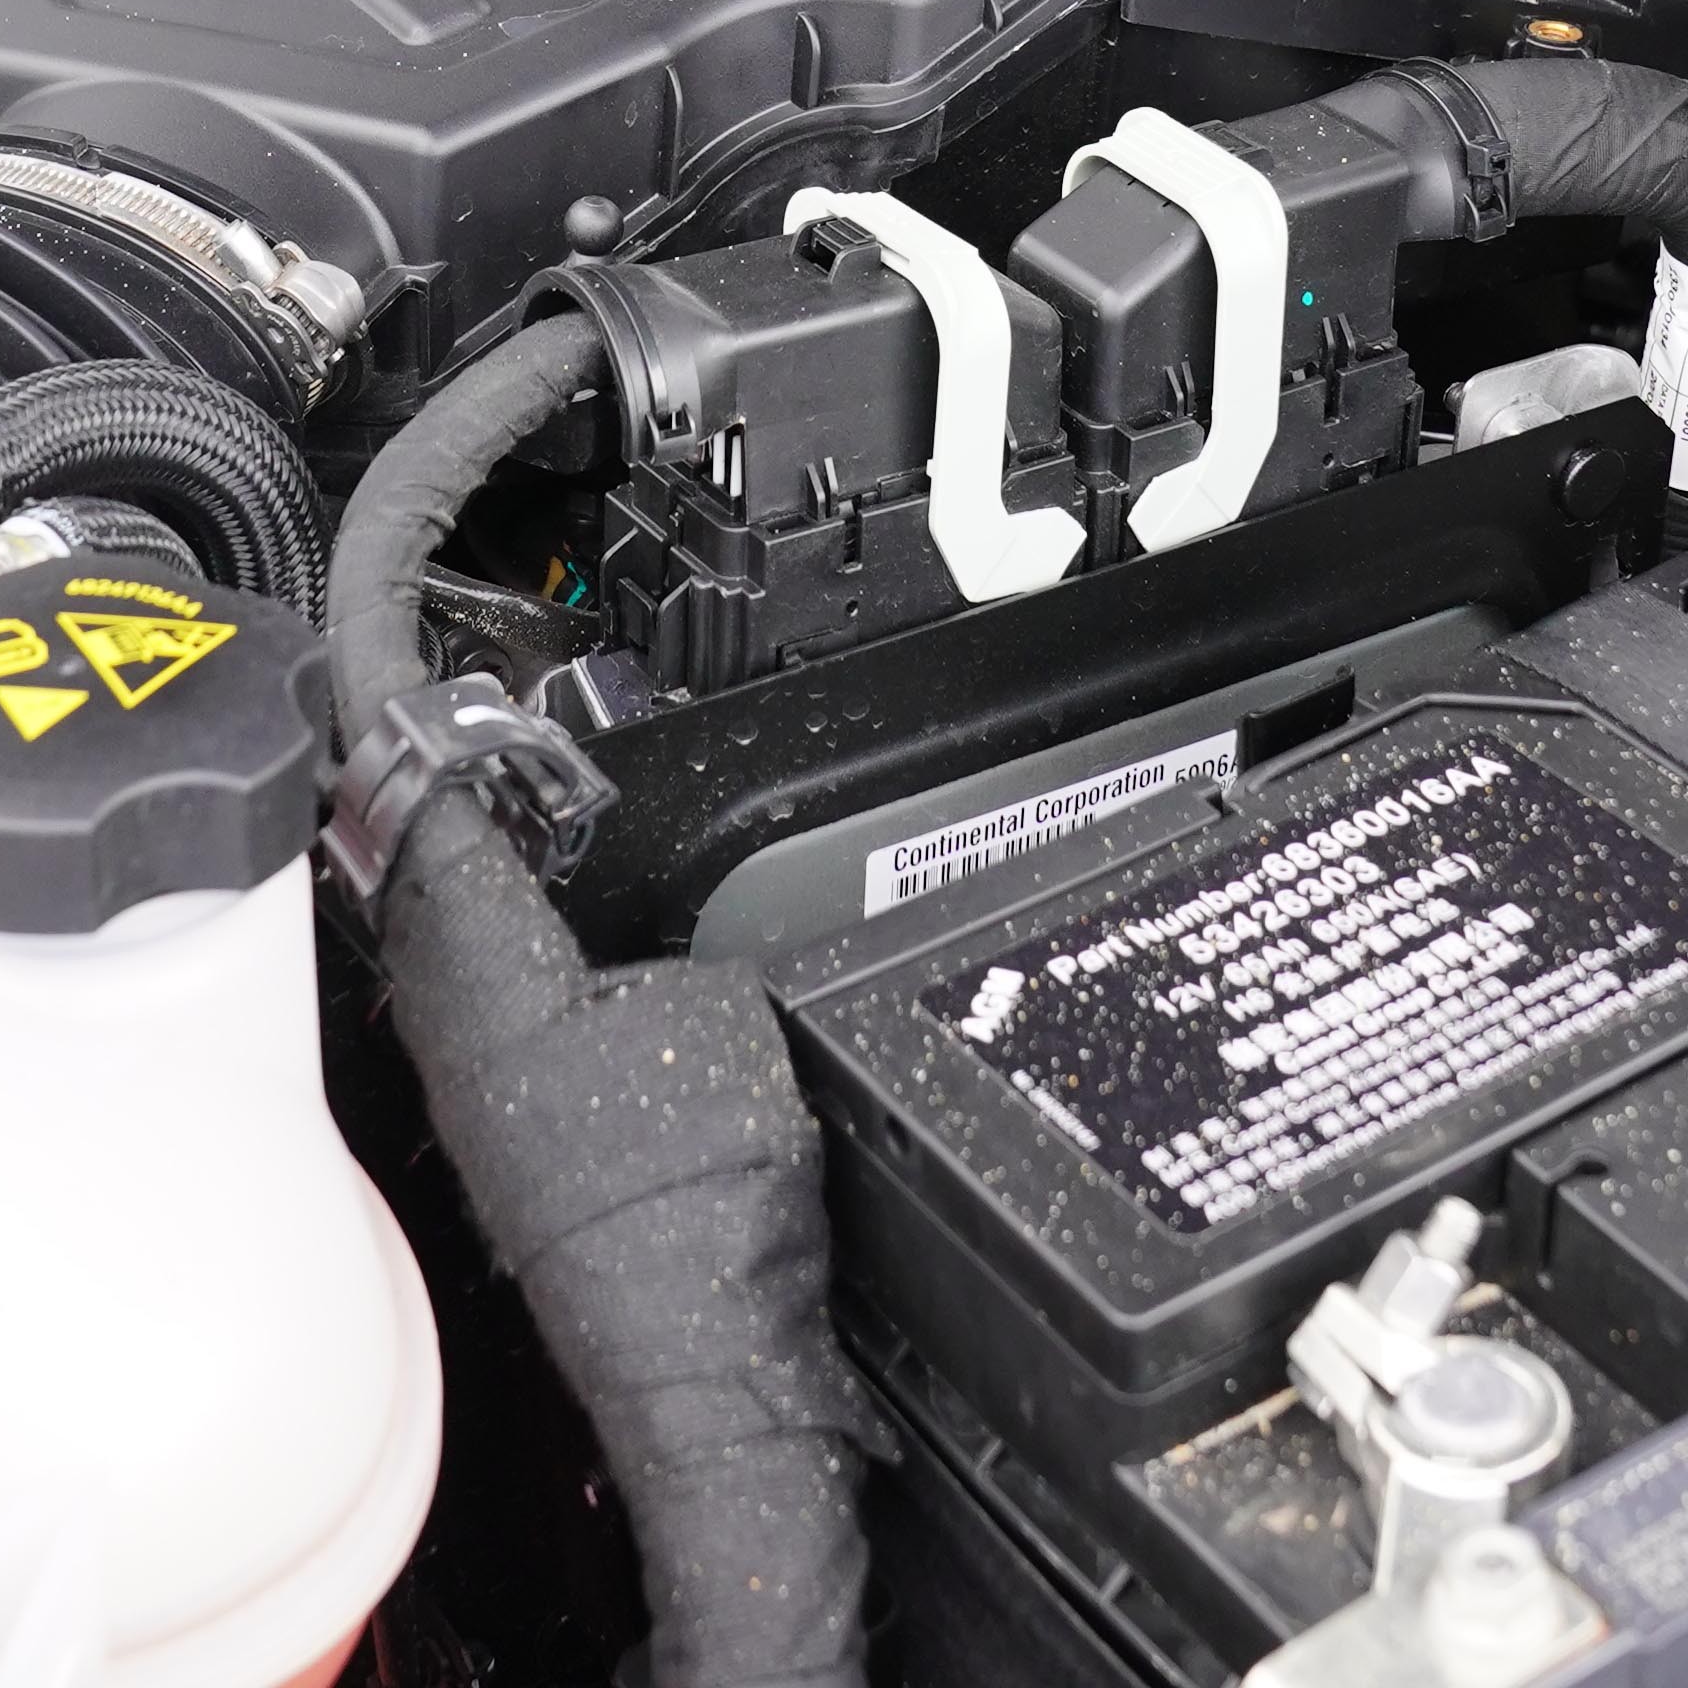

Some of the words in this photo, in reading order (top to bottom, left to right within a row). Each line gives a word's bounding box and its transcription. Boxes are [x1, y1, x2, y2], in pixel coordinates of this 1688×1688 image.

[894, 808, 1025, 872] Continental
[1036, 763, 1166, 824] Corporation
[1047, 935, 1132, 984] Part
[1262, 757, 1510, 880] 68360016AA
[961, 966, 1025, 1045] AGM
[1155, 975, 1214, 1017] 12V
